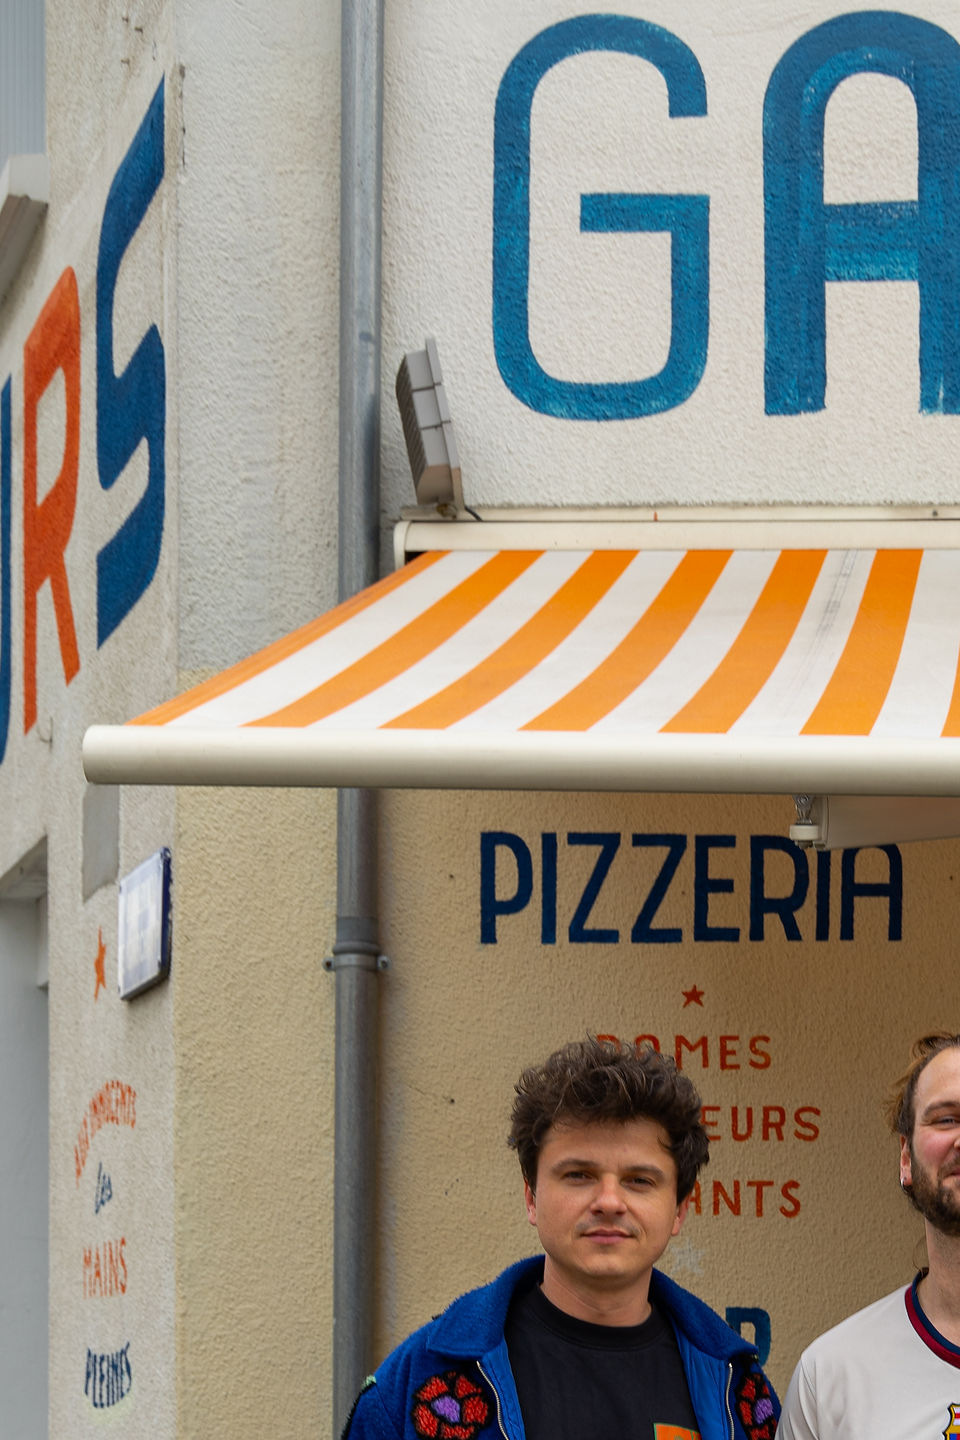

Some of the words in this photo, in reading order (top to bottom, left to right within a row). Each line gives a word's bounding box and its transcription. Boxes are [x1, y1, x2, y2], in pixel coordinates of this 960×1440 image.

[0, 70, 166, 762] RS
[479, 831, 903, 944] PIZZERIA
[82, 1236, 128, 1299] MAINS
[84, 1341, 132, 1409] PLEINES
